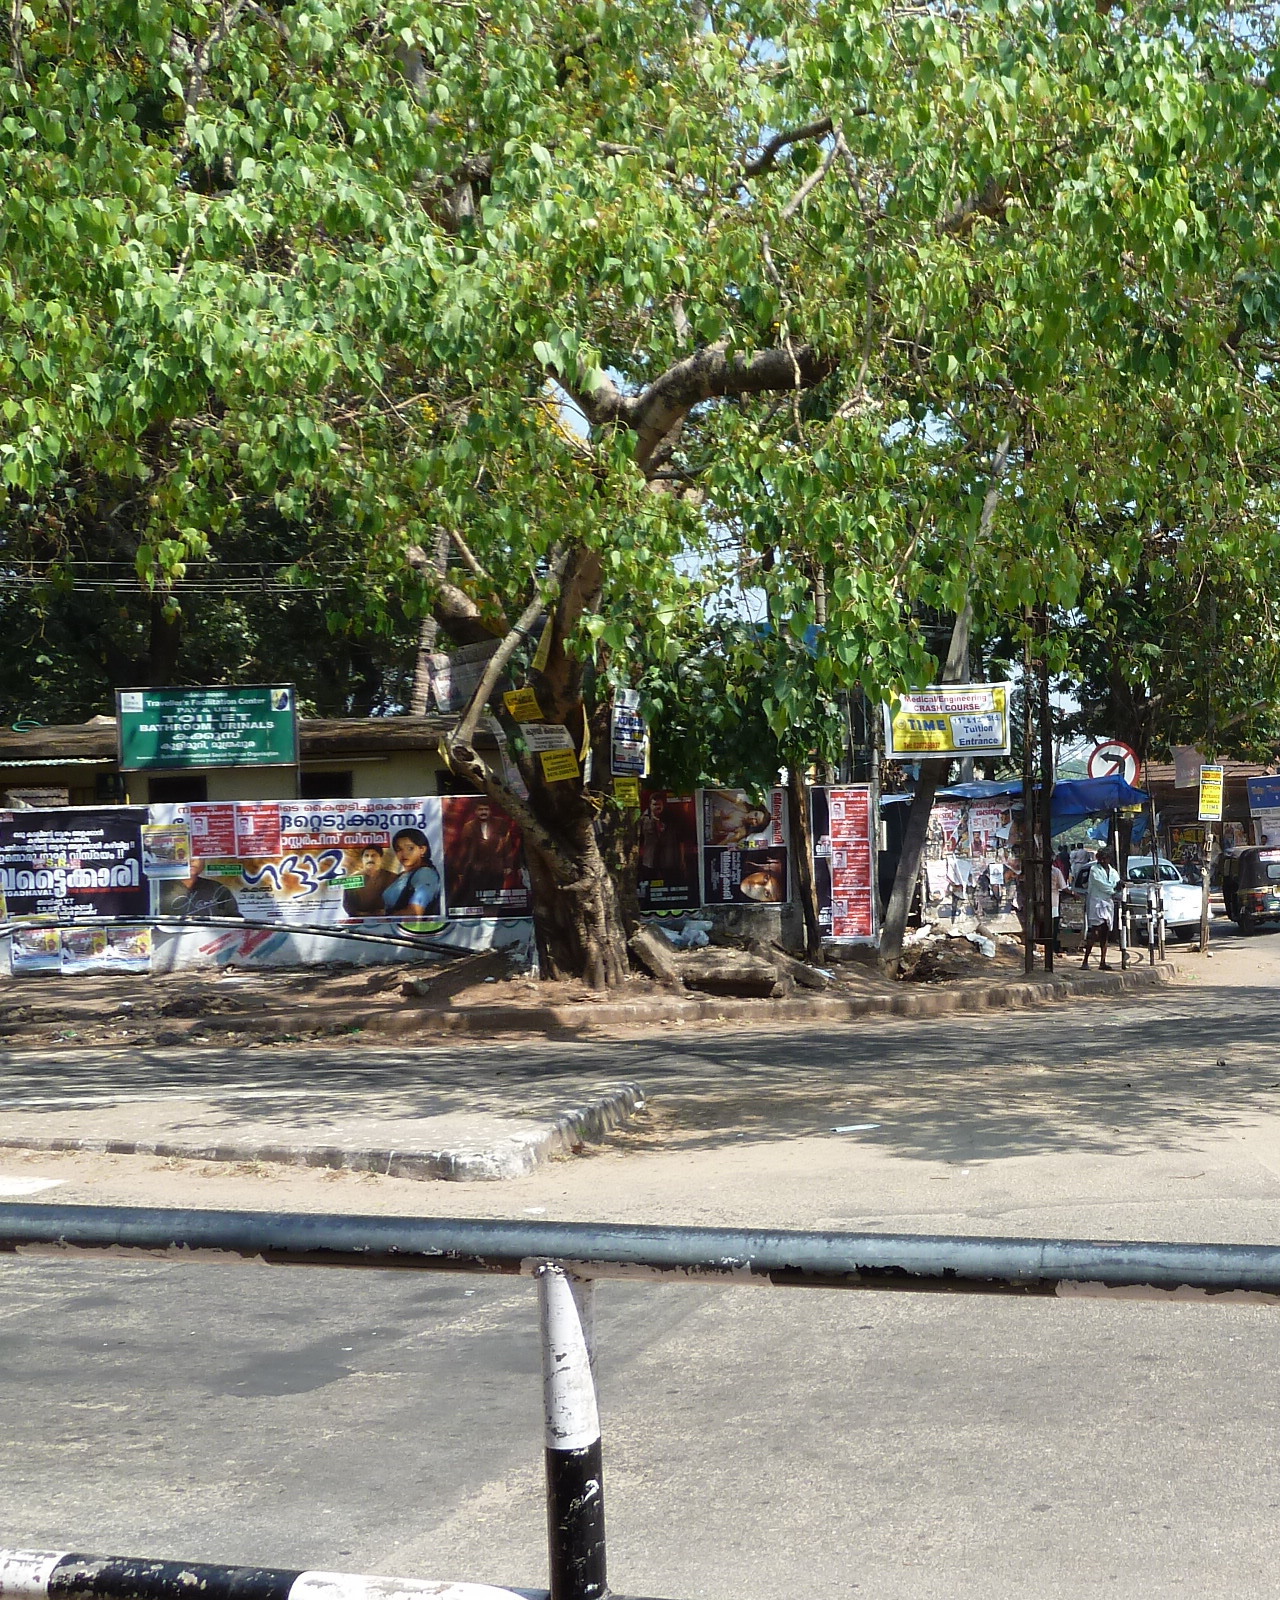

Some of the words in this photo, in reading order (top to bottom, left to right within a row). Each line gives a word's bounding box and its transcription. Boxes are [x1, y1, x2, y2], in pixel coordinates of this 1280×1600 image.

[145, 699, 189, 707] Traveller's
[237, 697, 266, 705] Center
[904, 694, 987, 704] Medical/Engineering
[914, 704, 943, 712] CRASH
[945, 703, 980, 711] COURSE
[161, 713, 252, 723] TOILET
[219, 721, 275, 730] URINALS
[908, 719, 946, 731] TIME
[963, 724, 993, 734] Tuition
[958, 737, 999, 746] Entrance
